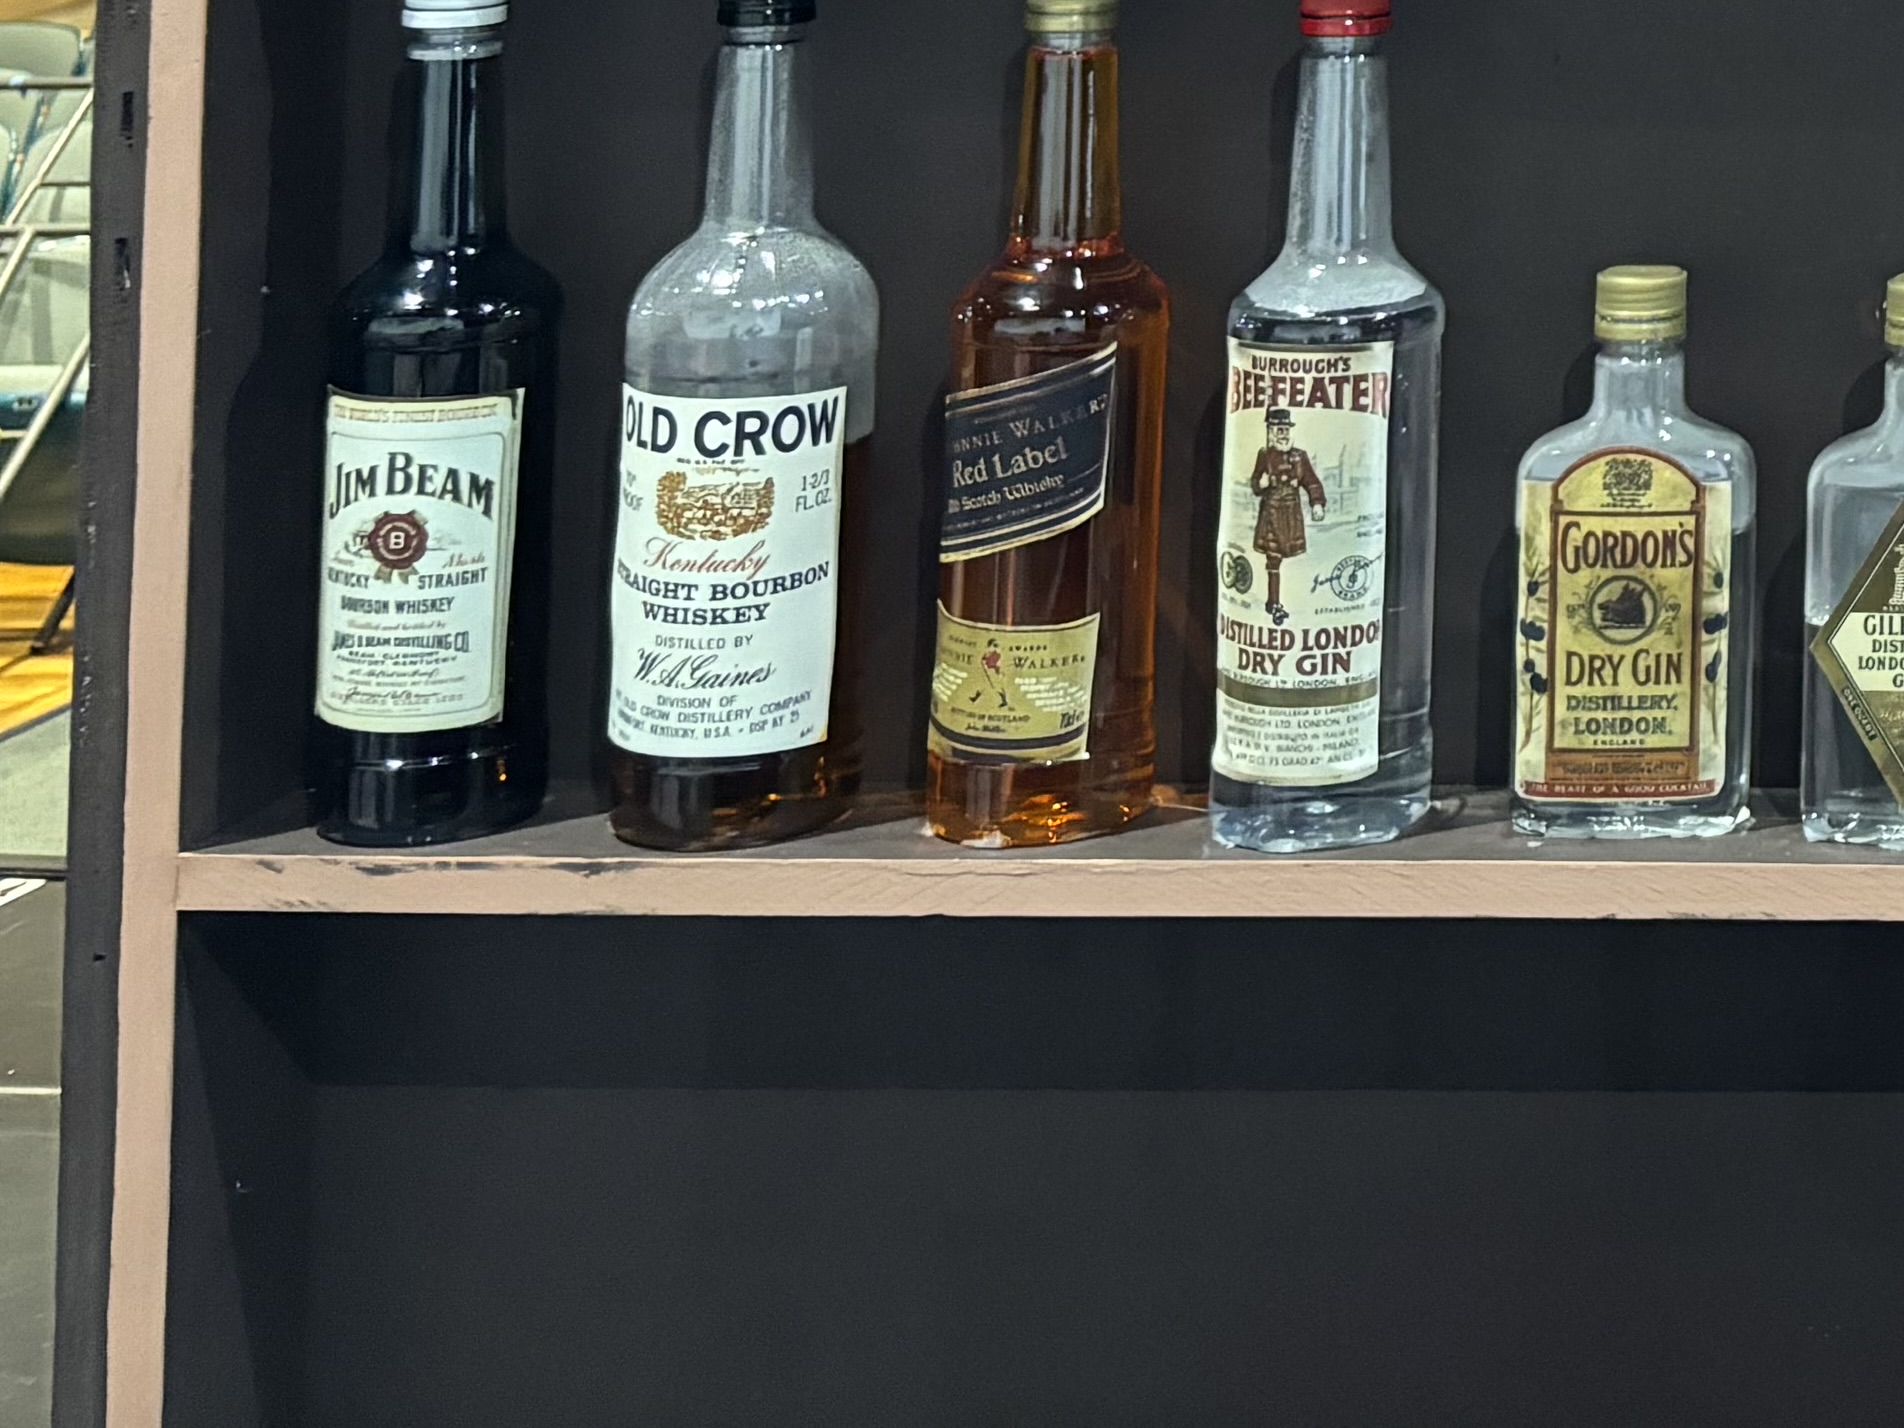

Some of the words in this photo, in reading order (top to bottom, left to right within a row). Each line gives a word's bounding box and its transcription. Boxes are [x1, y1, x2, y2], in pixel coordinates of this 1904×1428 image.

[1251, 354, 1352, 375] BURROUGH'S
[1230, 365, 1389, 418] BEEFEATER
[625, 394, 678, 454] OLD
[693, 395, 840, 459] CROW
[952, 457, 989, 488] Red
[991, 436, 1068, 478] Label
[328, 462, 381, 520] JIM
[385, 451, 495, 520] BEAM
[390, 531, 405, 550] B
[1560, 521, 1694, 575] GORDON'S
[645, 536, 772, 582] Kentucky
[417, 566, 488, 590] STRAIGHT
[710, 561, 830, 602] BOURBON
[642, 600, 771, 625] WHISKEY
[655, 634, 727, 650] DISTILLED
[734, 634, 754, 647] BY
[1237, 649, 1284, 675] DRY
[1295, 648, 1353, 675] GIN
[1564, 650, 1626, 687] DRY
[1631, 648, 1683, 685] GIN
[657, 694, 712, 709] DIVISION
[719, 695, 738, 707] OF
[678, 707, 753, 725] DISTILLERY
